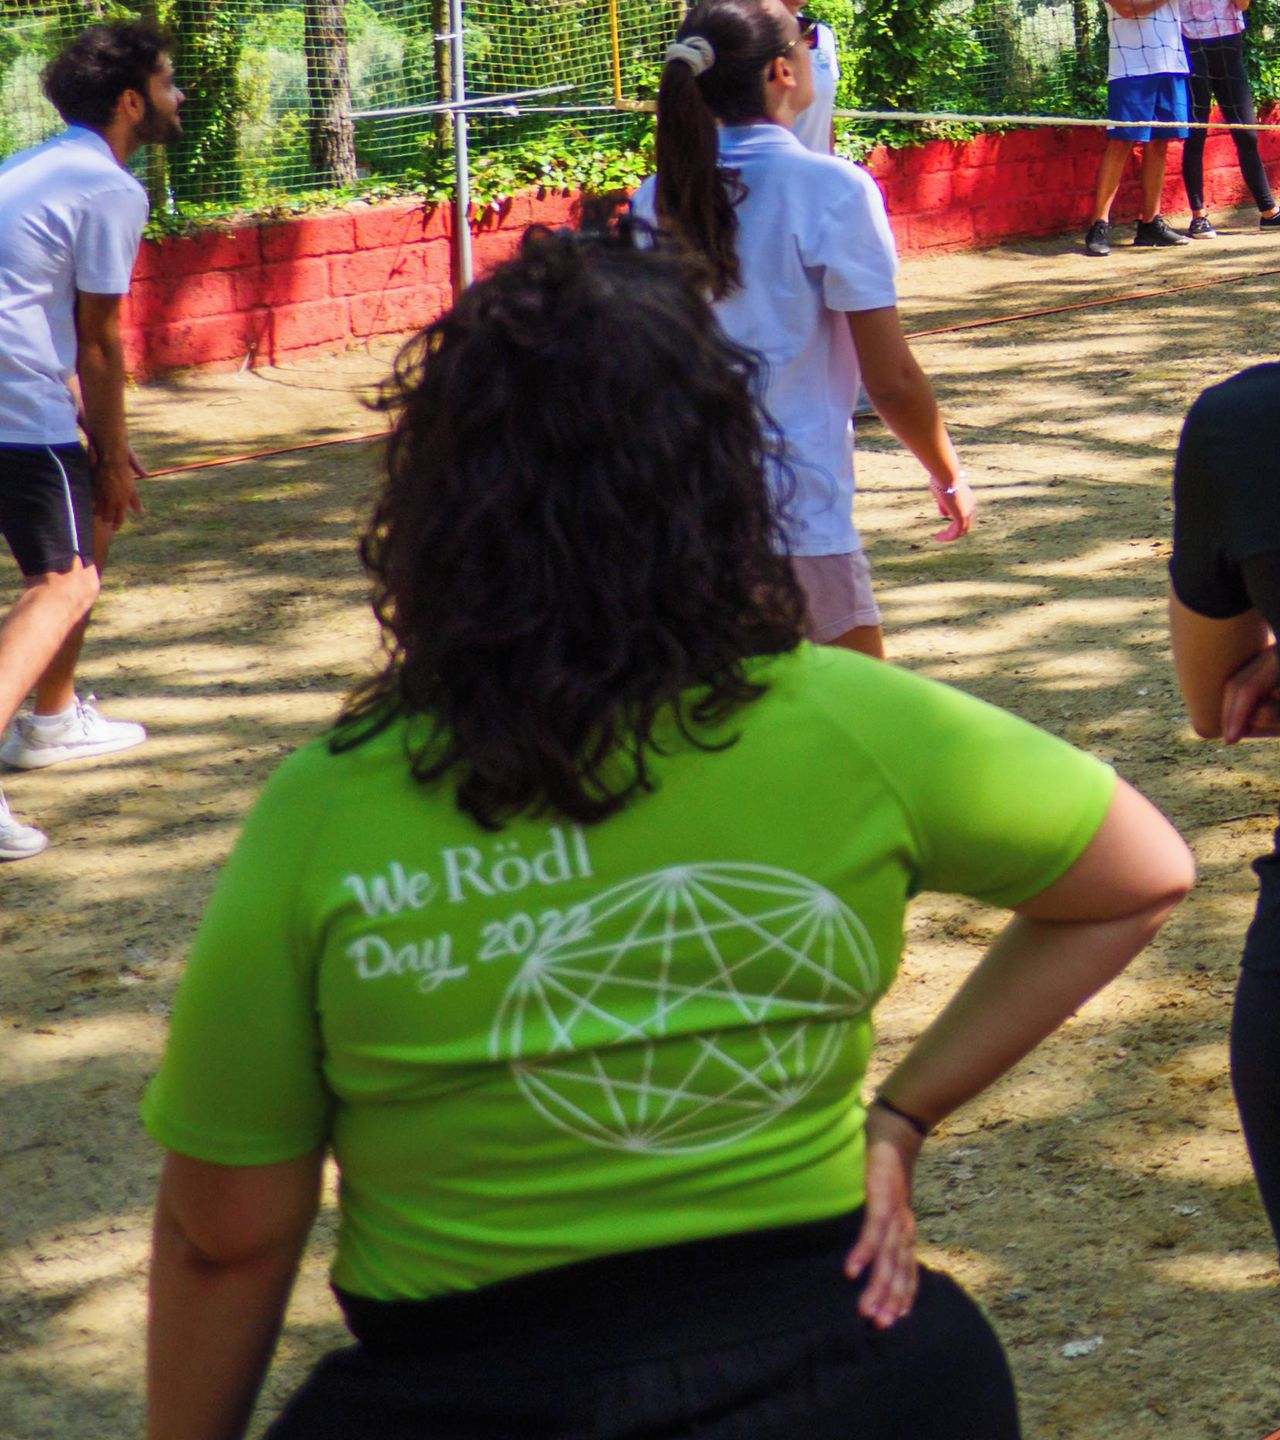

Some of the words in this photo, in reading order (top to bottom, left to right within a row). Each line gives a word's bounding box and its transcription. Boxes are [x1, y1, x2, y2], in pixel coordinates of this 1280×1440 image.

[343, 861, 438, 918] We
[441, 824, 593, 903] Rödl
[347, 932, 469, 993] Day
[478, 904, 593, 961] 2022
